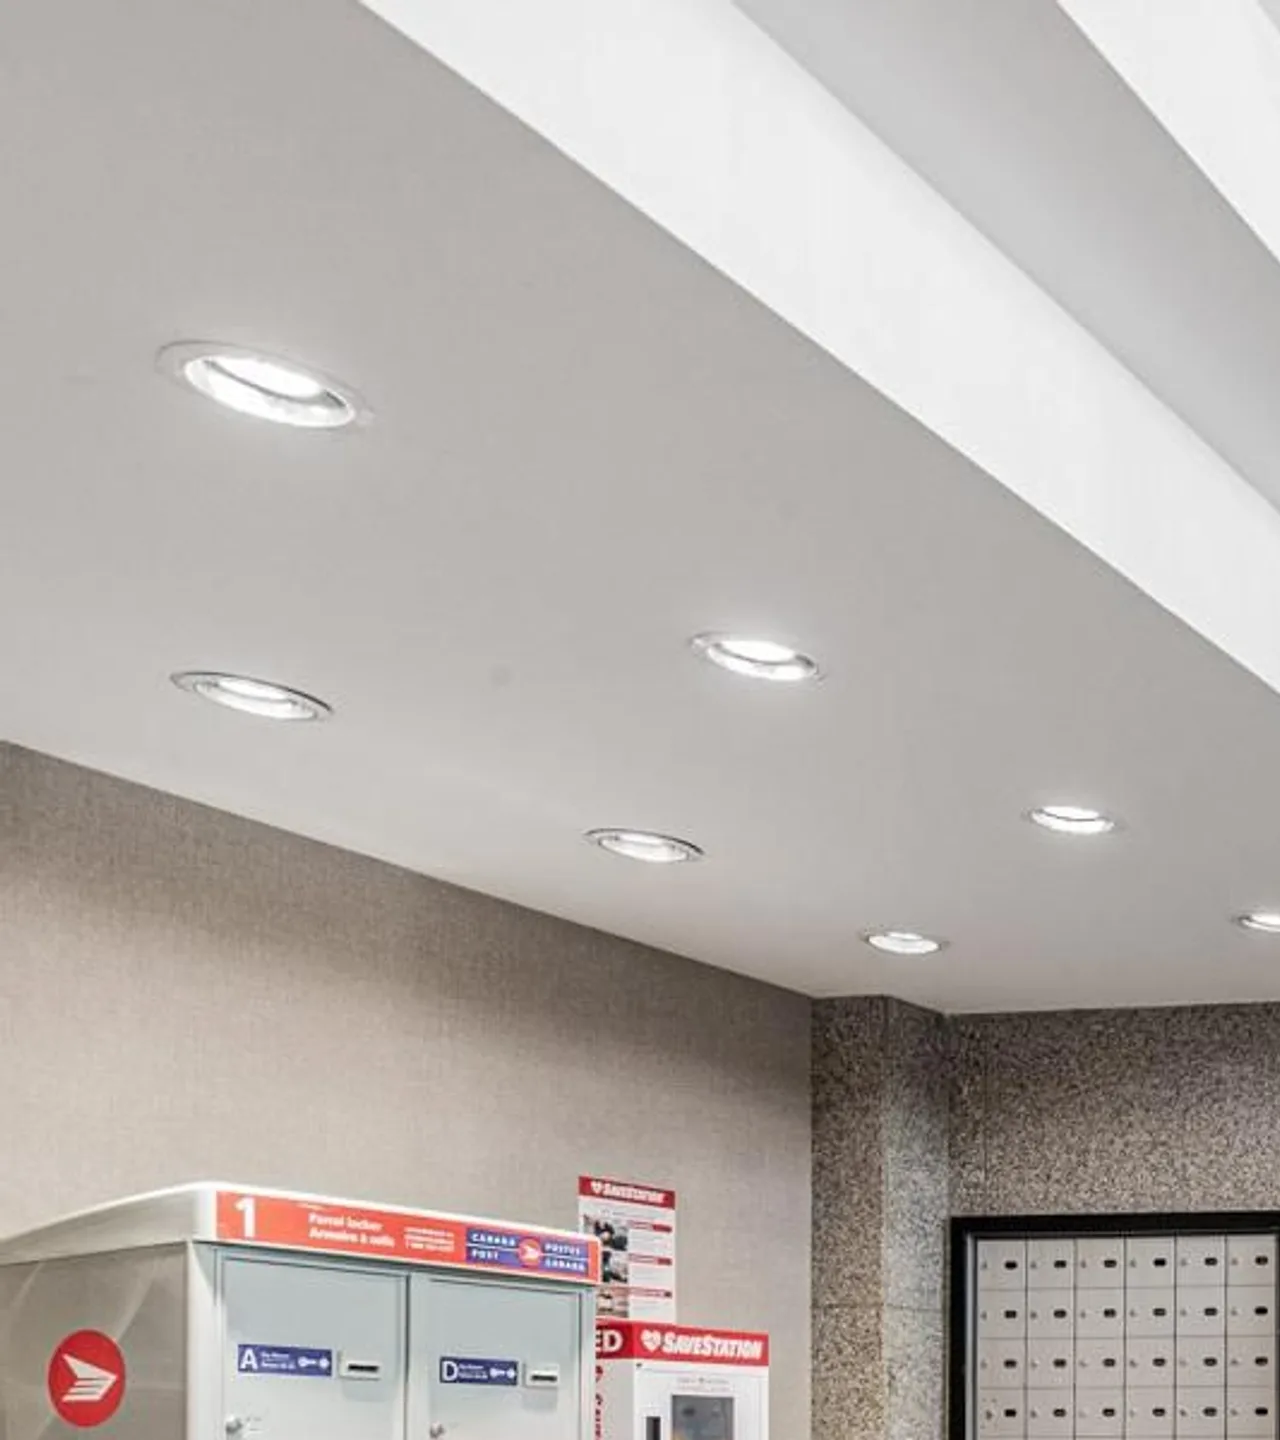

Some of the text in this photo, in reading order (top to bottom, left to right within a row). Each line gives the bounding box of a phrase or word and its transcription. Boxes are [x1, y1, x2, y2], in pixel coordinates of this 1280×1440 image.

[235, 1197, 256, 1239] 1
[240, 1348, 259, 1370] A
[442, 1361, 458, 1381] D
